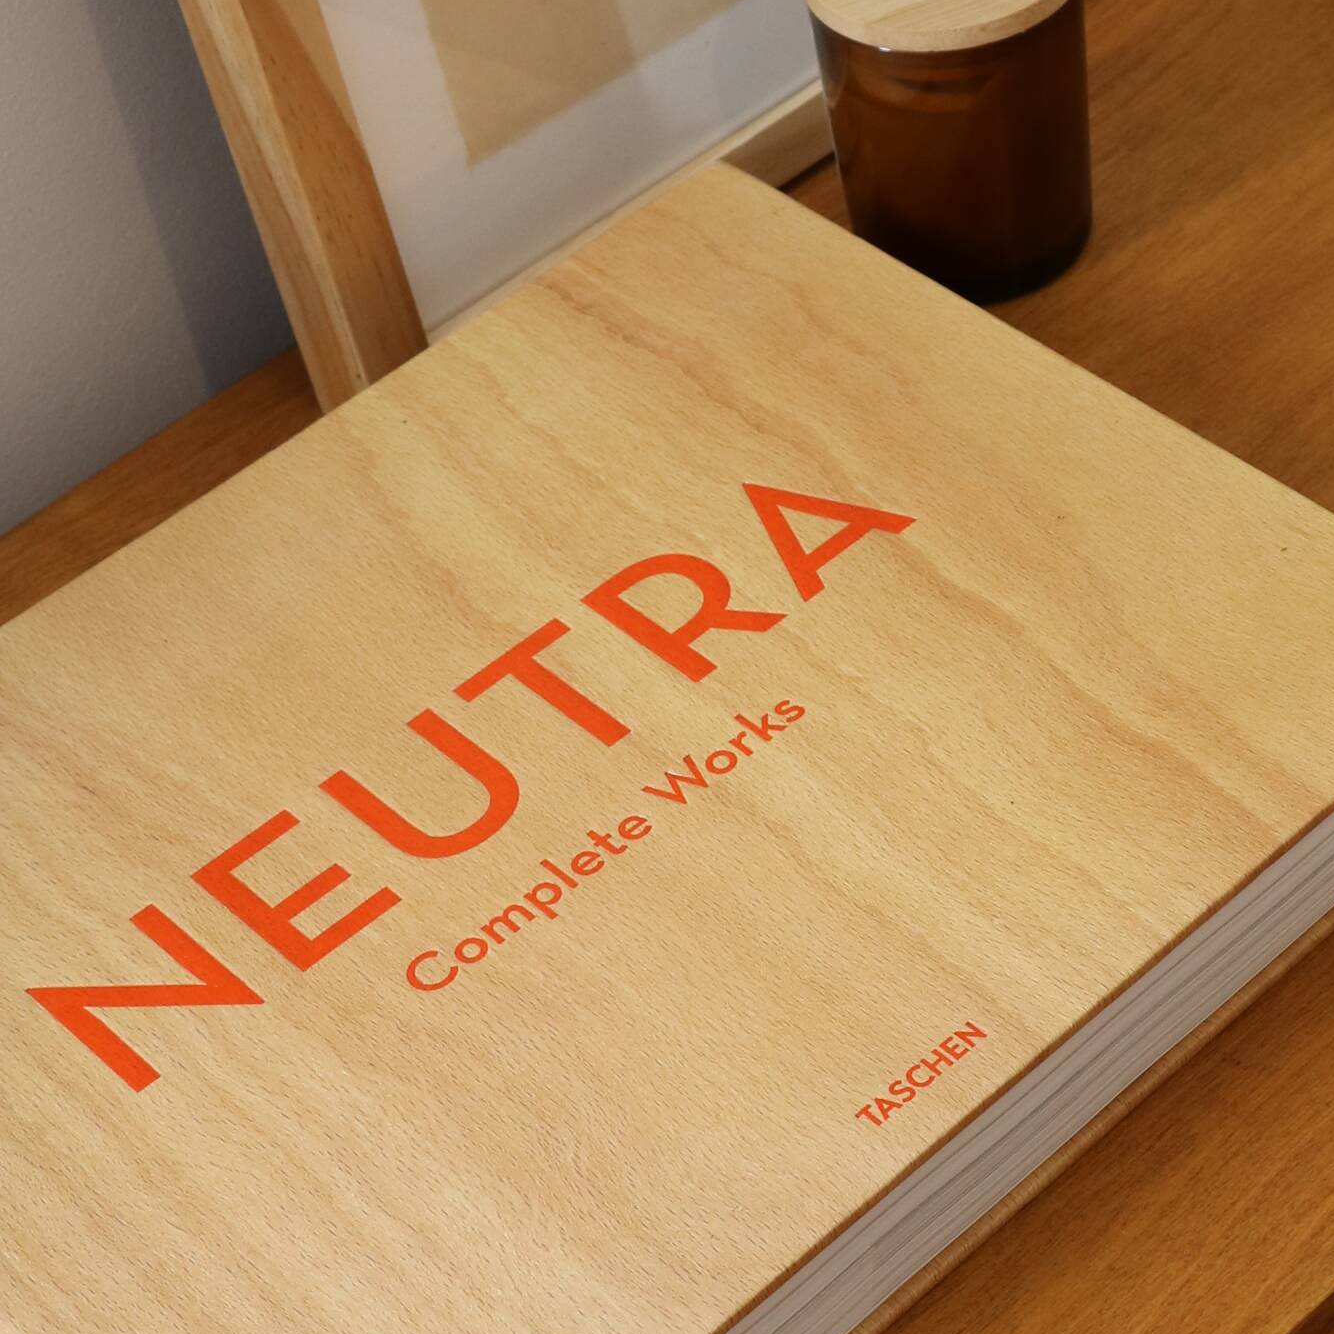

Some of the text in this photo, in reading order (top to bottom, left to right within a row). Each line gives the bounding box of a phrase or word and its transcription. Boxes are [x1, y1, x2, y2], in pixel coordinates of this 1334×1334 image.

[26, 482, 917, 1094] NEUTRA
[406, 698, 806, 992] Complete Works
[855, 1021, 988, 1127] TASCHEN
